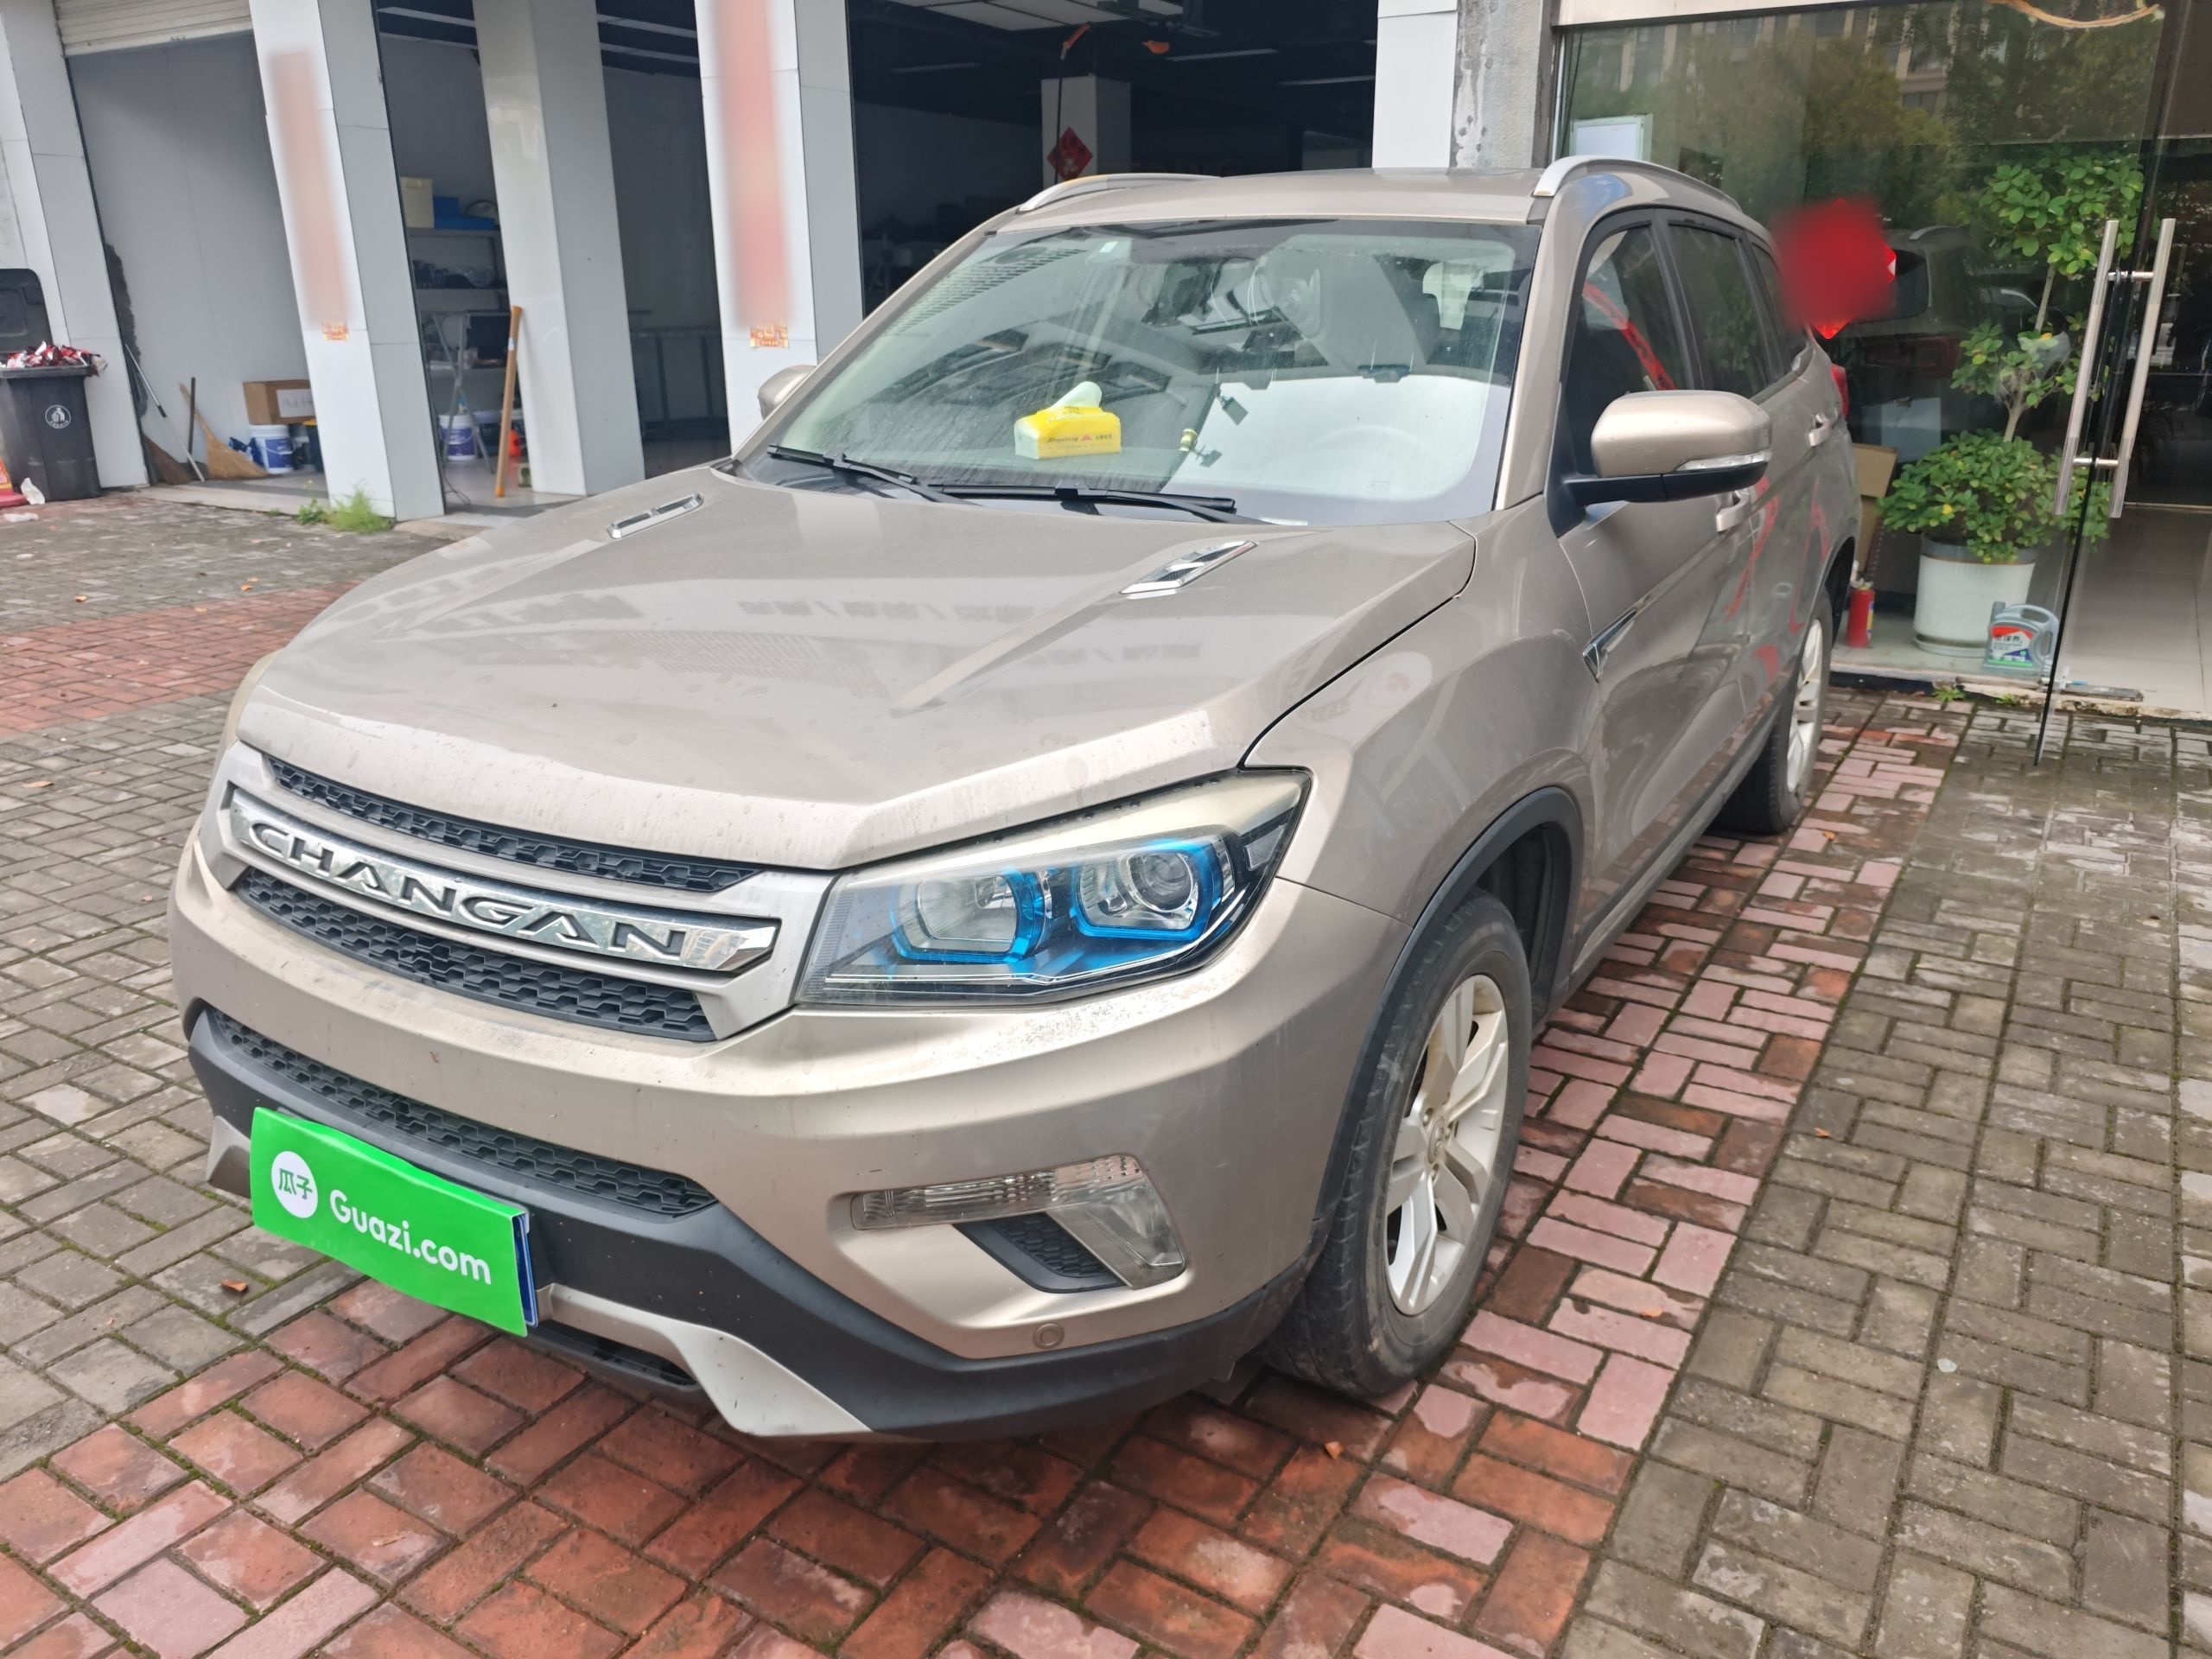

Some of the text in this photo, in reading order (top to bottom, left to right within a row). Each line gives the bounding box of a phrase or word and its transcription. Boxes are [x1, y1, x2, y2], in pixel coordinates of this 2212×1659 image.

[248, 822, 688, 959] CHANGAN
[278, 1167, 313, 1201] 瓜子
[329, 1189, 492, 1286] Guazi.com
